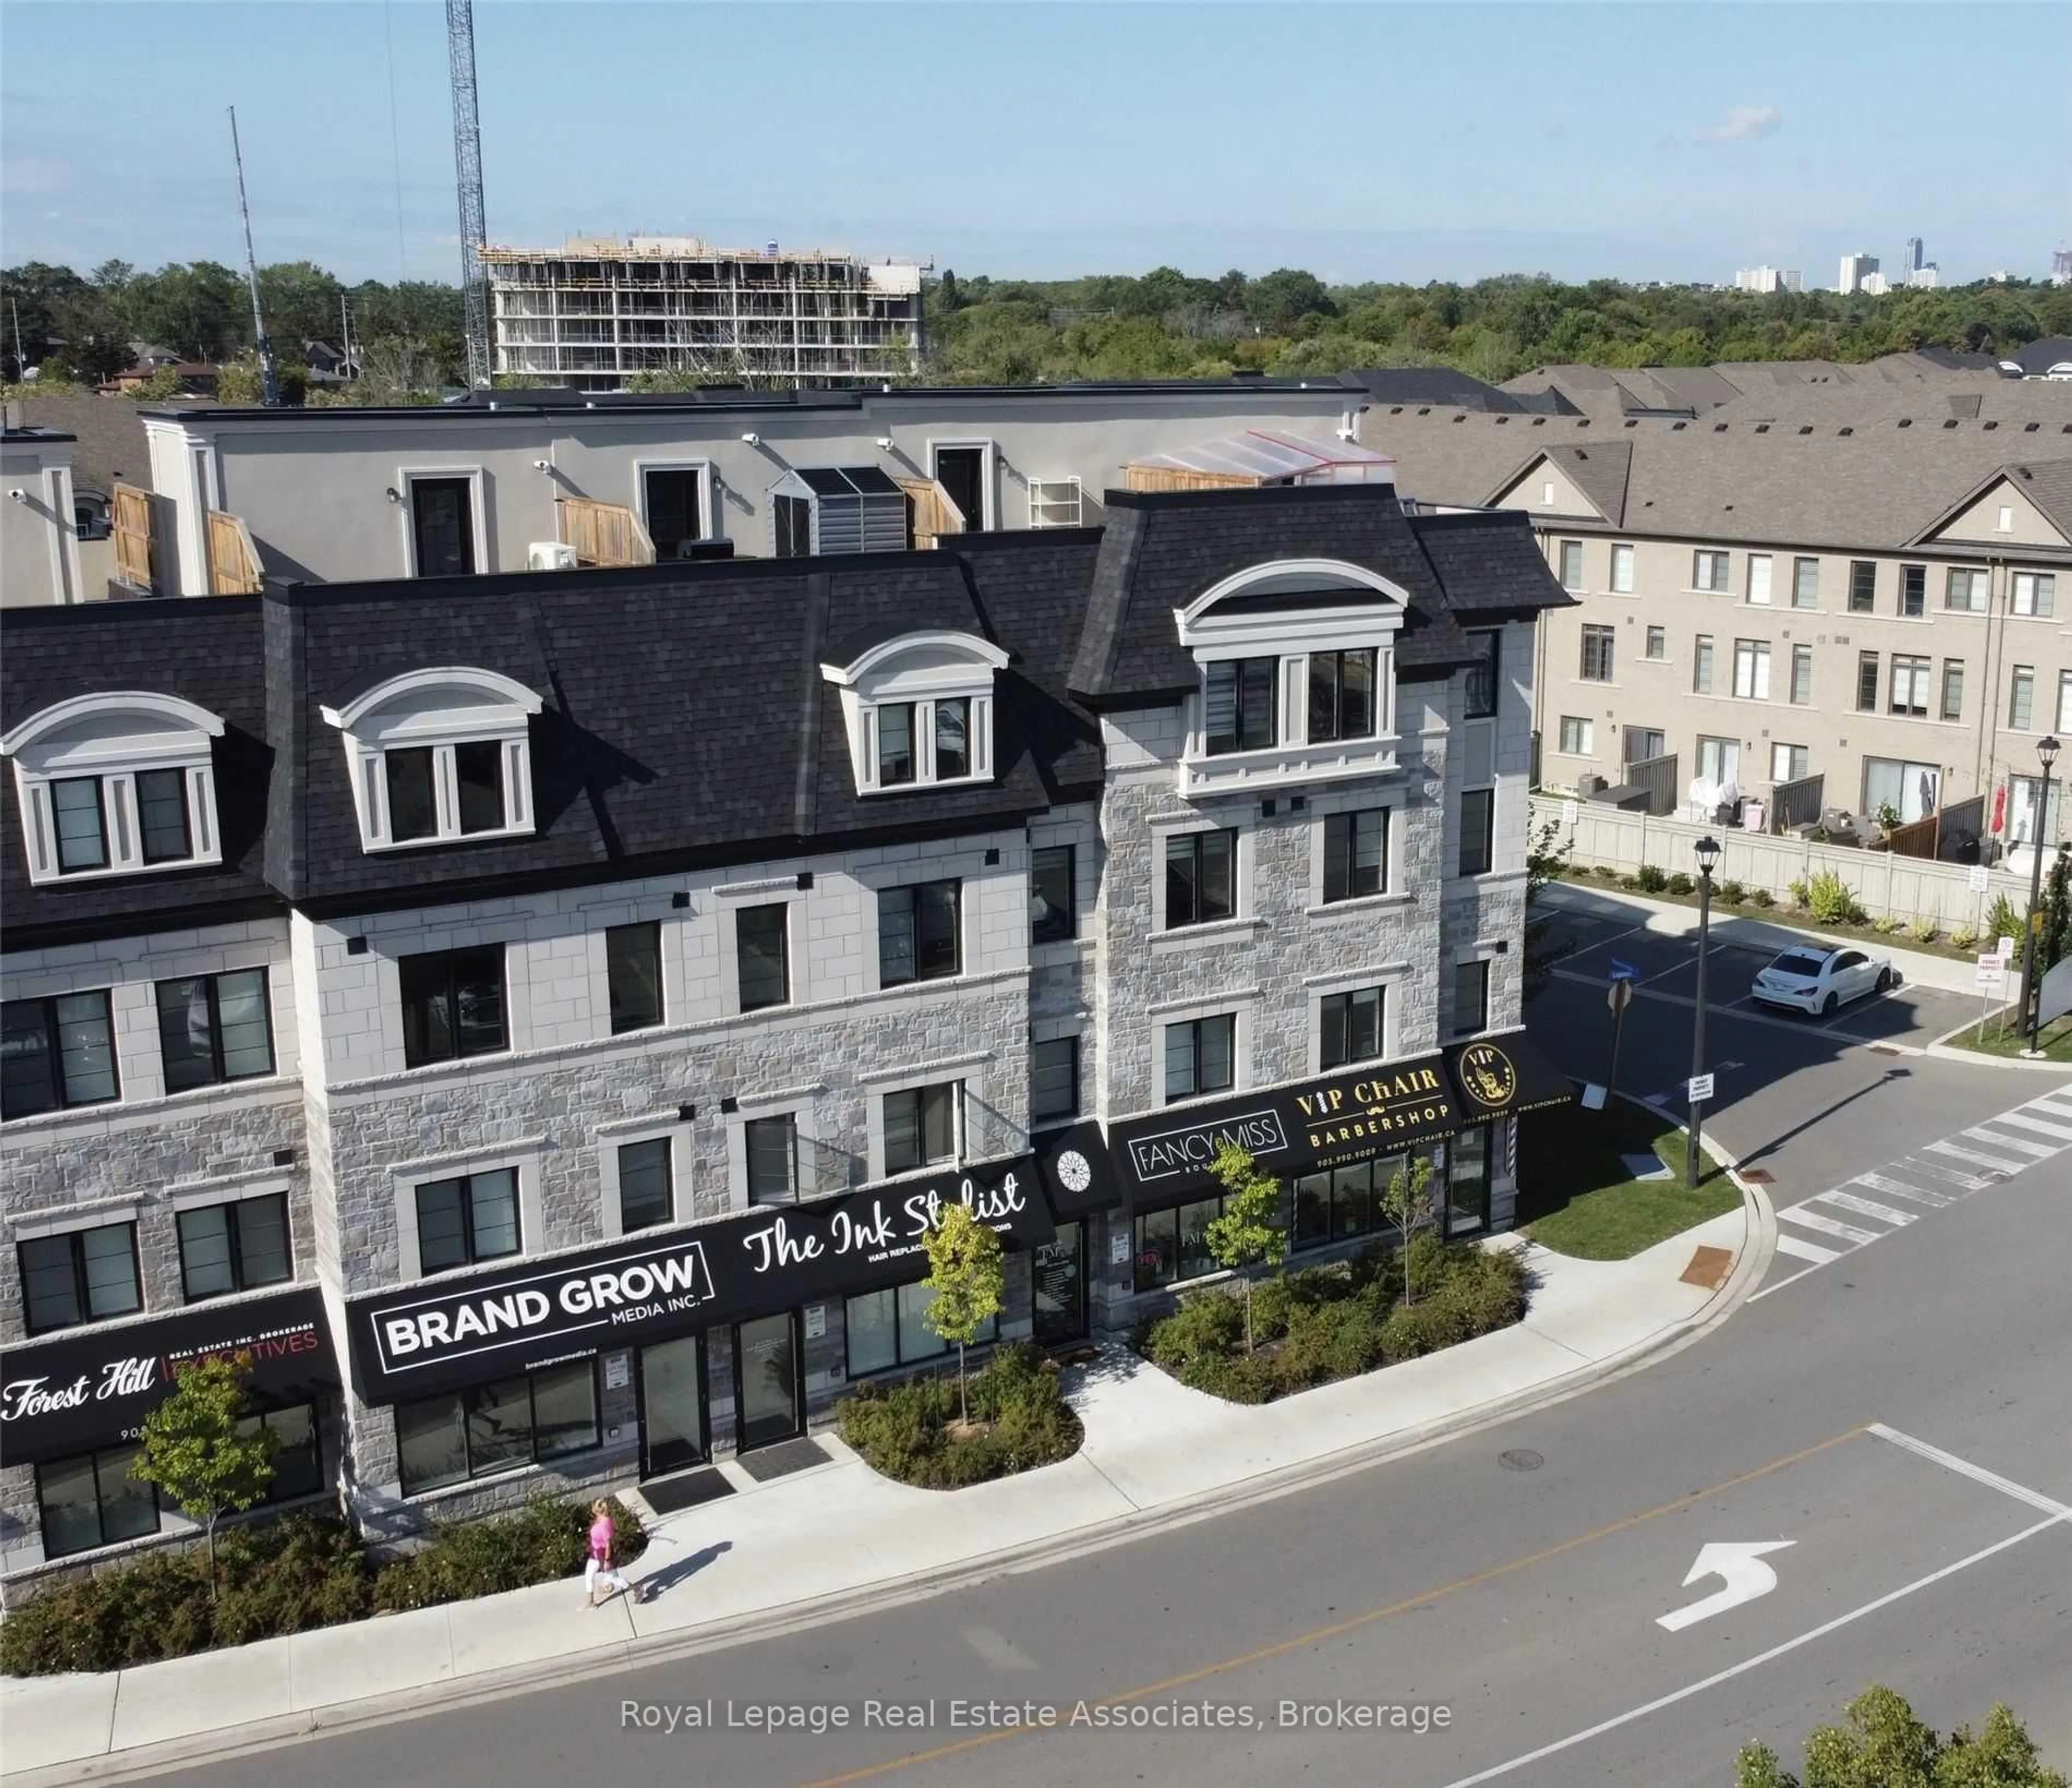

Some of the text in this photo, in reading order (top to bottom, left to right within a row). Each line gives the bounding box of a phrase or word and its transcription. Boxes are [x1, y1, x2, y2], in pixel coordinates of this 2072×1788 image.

[1468, 1050, 1494, 1065] VIP
[1137, 1119, 1277, 1171] FANCY MISS
[1310, 1105, 1449, 1147] BARBERSHOP
[744, 1172, 1026, 1273] The Ink Stlist
[868, 1252, 889, 1263] HAIR
[386, 1255, 694, 1356] BRAND GROW
[611, 1294, 701, 1325] MEDIA INC.
[169, 1349, 194, 1360] REAL
[197, 1341, 232, 1354] ESTATE
[259, 1322, 315, 1341] BROKERAGE
[1, 1356, 157, 1421] Forest Hill
